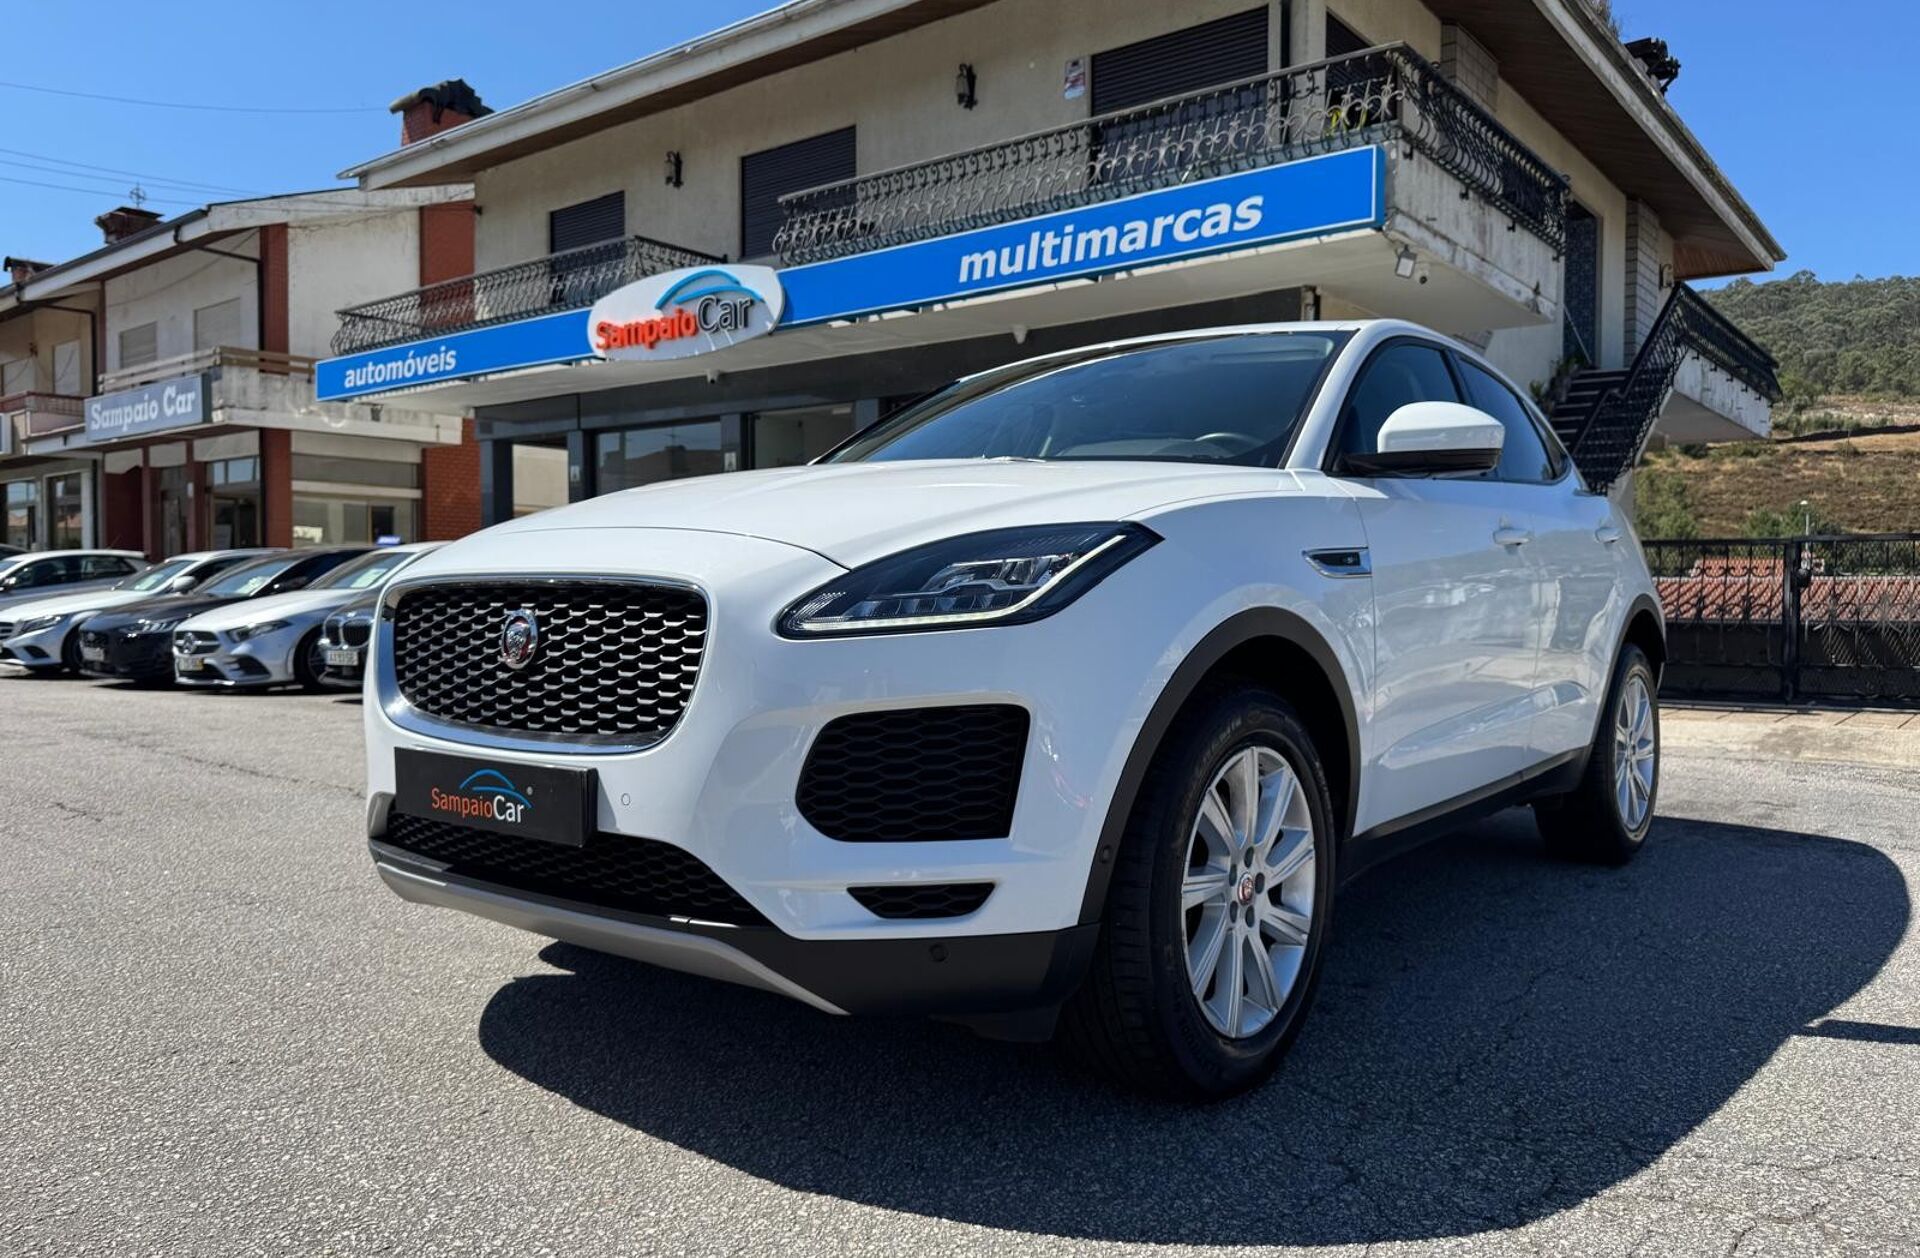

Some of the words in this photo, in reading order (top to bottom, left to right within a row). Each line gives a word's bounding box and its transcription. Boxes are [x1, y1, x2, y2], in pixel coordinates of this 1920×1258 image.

[960, 195, 1264, 282] multimarcas
[344, 347, 457, 389] automóveis
[91, 394, 158, 432] Sampaio
[163, 385, 196, 417] Car
